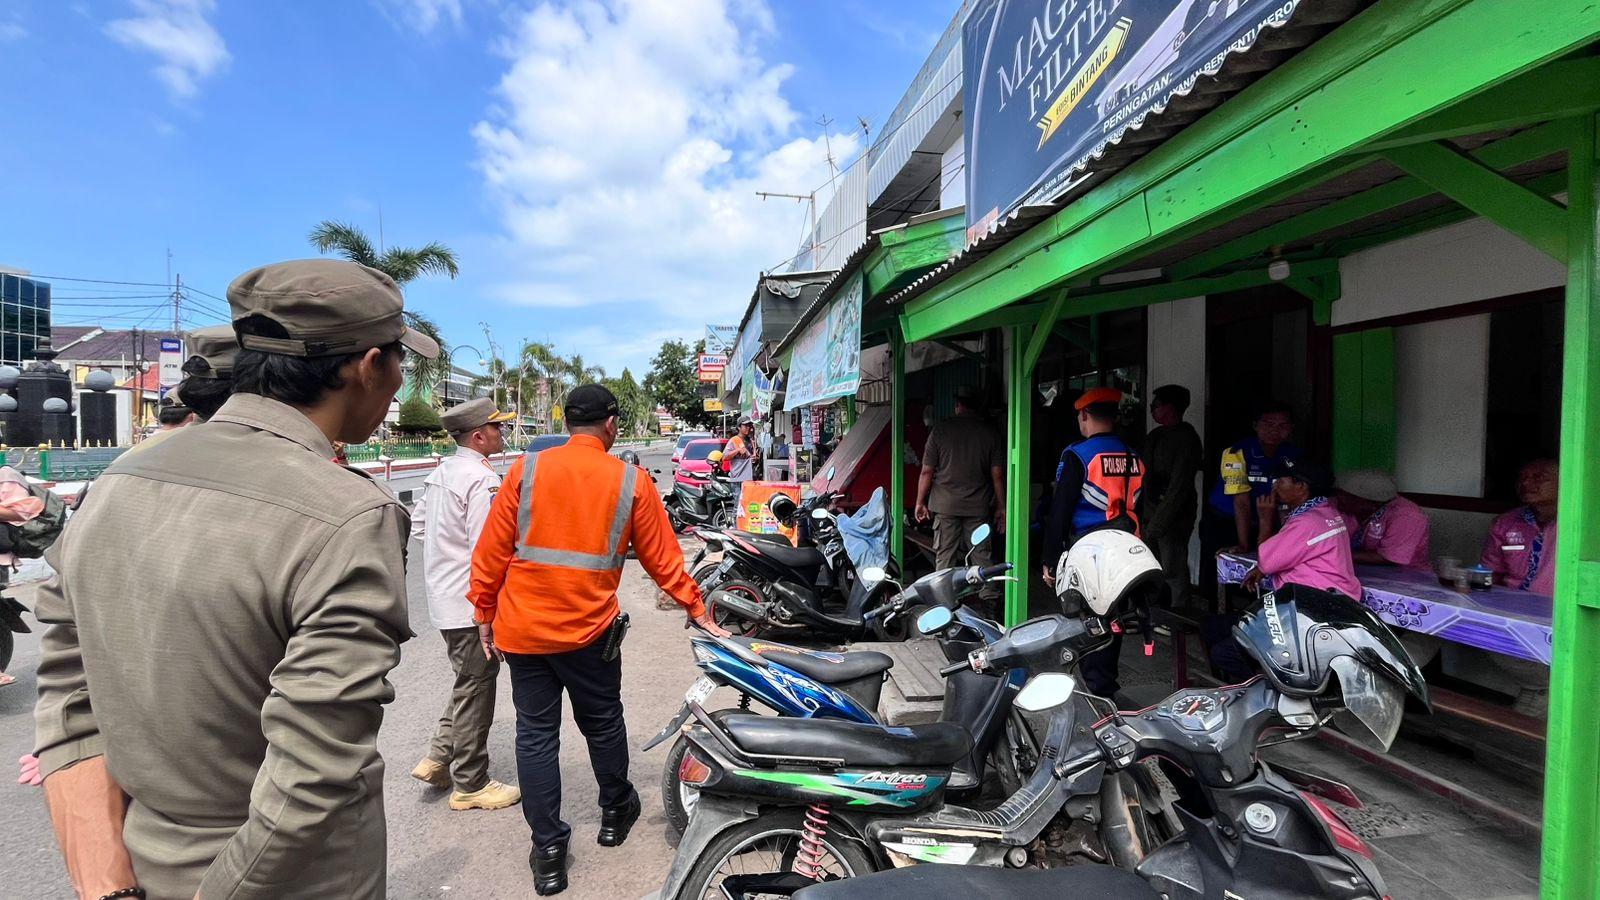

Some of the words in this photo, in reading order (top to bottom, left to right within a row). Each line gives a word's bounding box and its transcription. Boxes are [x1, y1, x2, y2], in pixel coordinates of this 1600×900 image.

[997, 0, 1077, 112] MAG
[1028, 0, 1120, 121] FILTE
[1070, 45, 1108, 103] BINTANG
[1103, 72, 1173, 133] PERINGATAN:
[1103, 457, 1139, 474] POLSUSA
[902, 836, 937, 846] HONDA
